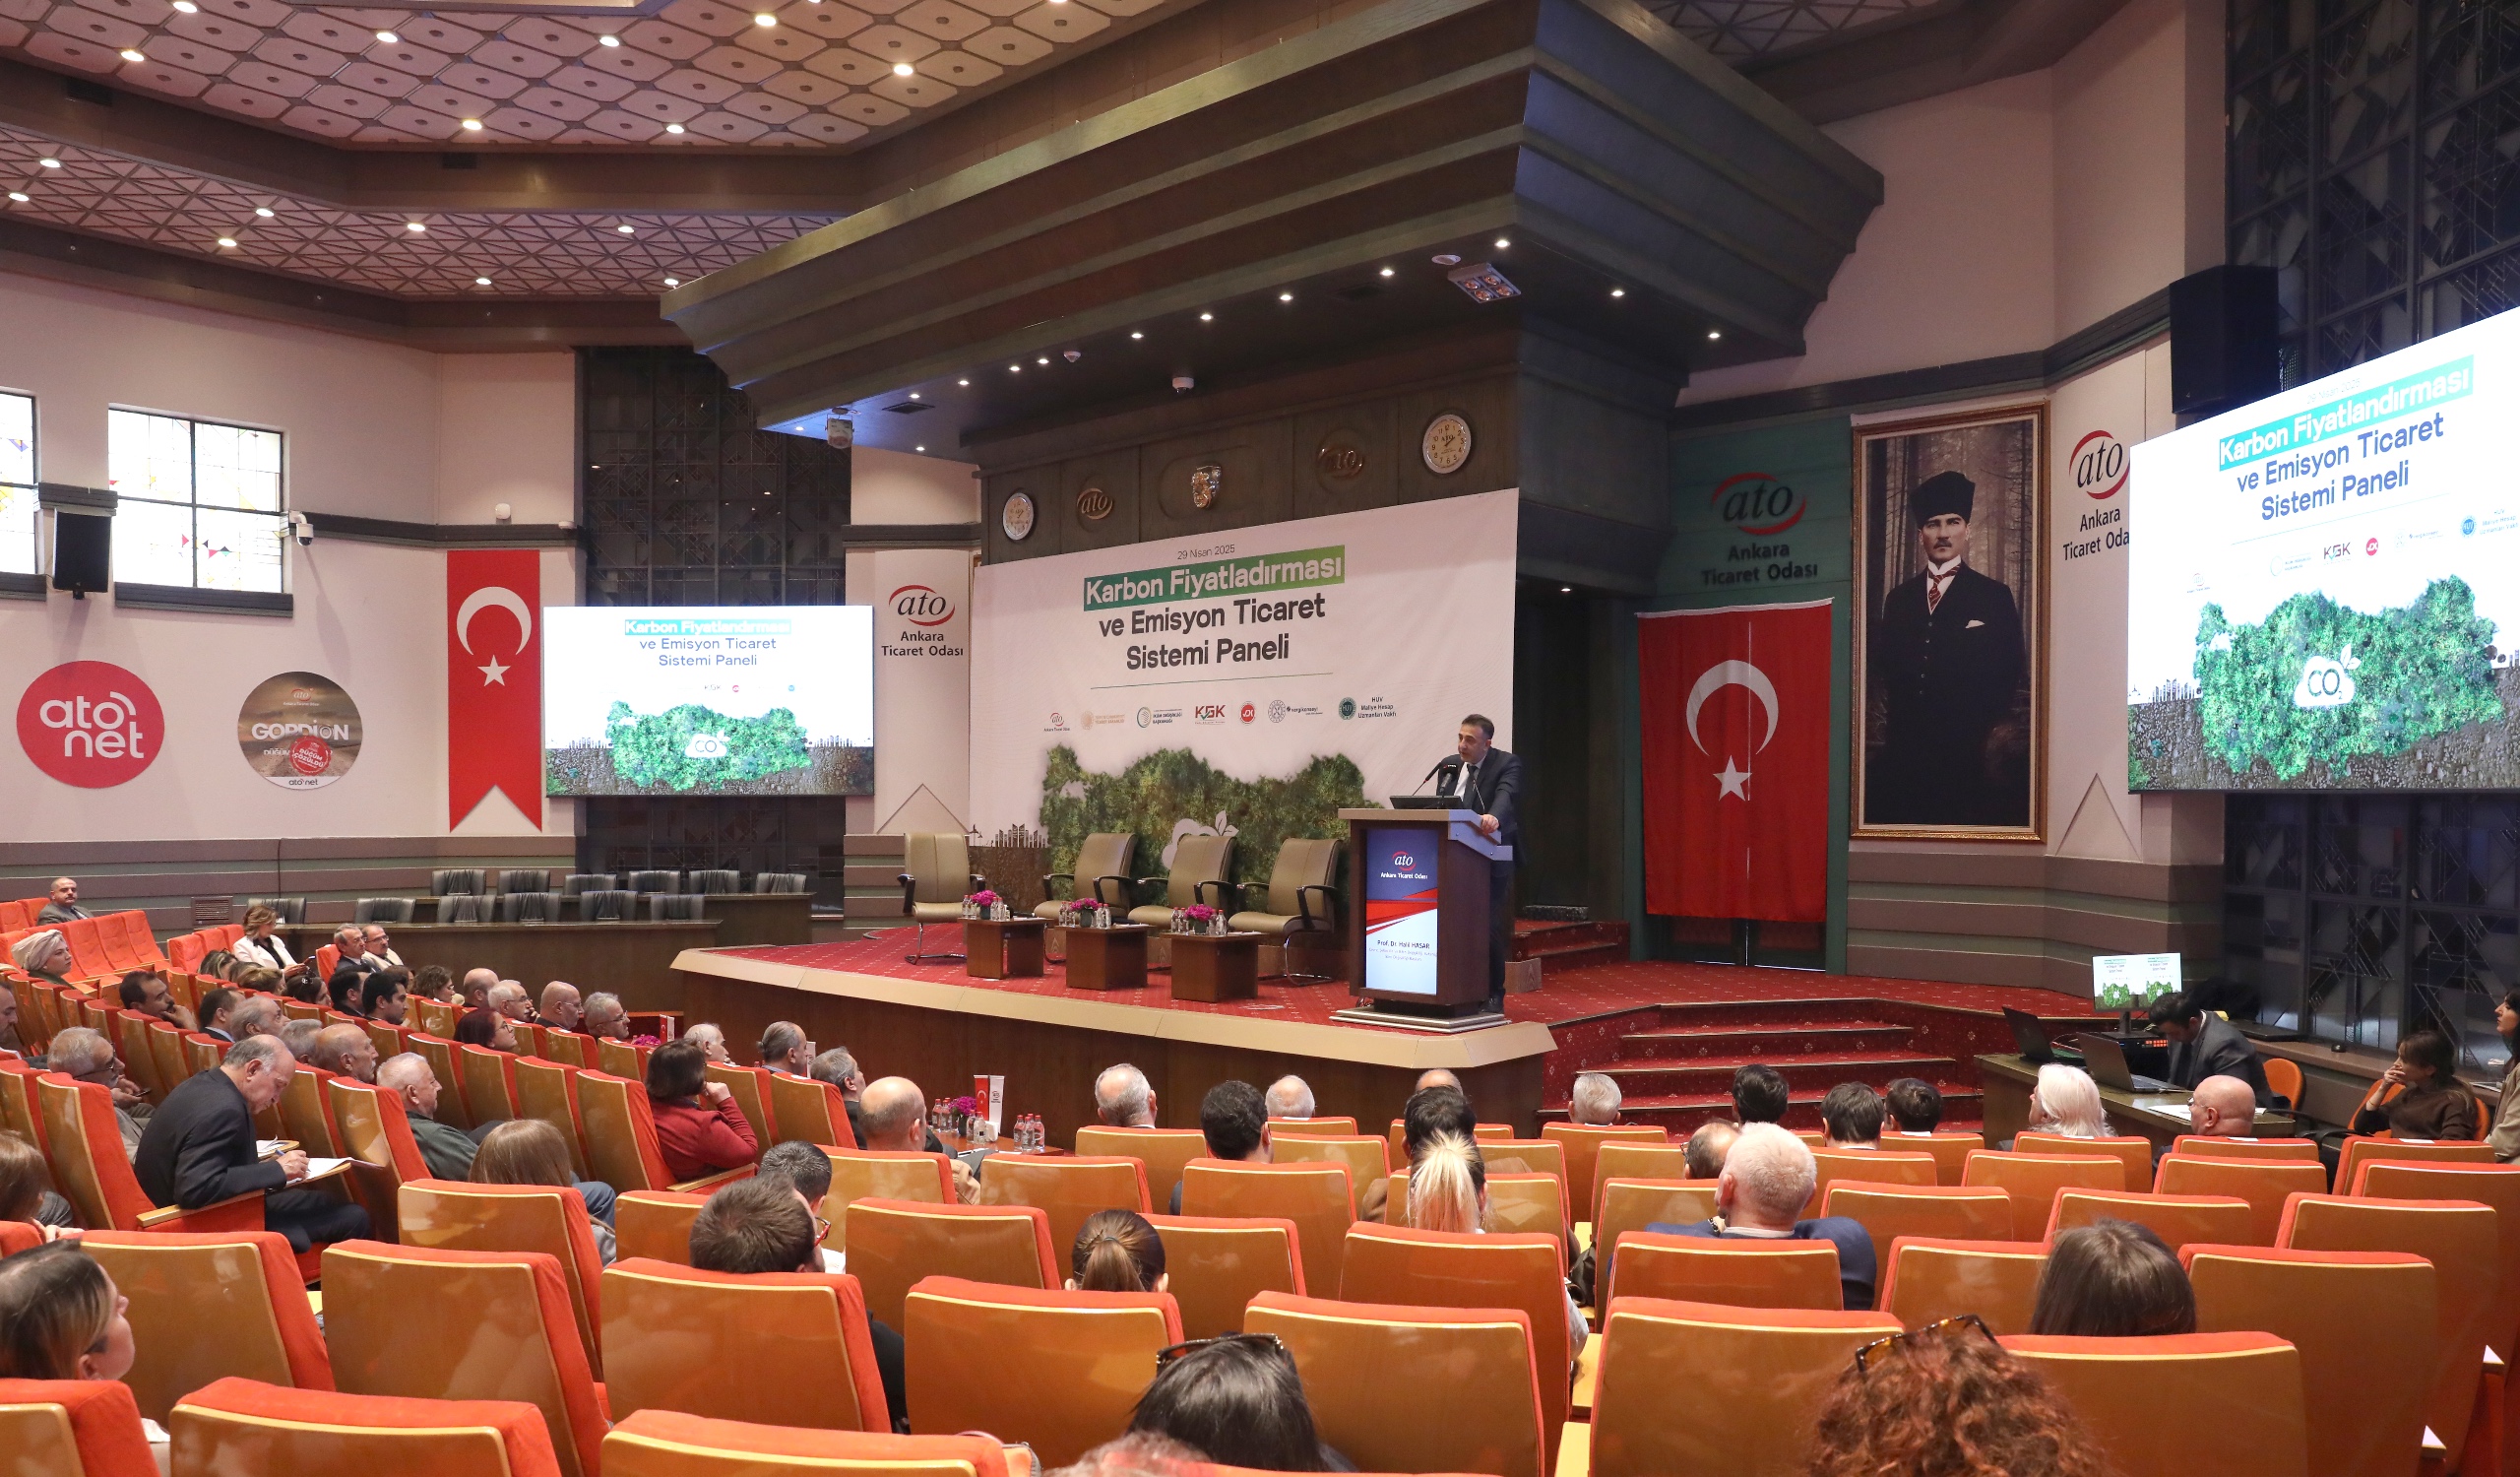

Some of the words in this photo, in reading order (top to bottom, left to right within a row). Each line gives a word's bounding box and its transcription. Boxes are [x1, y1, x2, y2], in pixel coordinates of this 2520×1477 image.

[2220, 427, 2288, 465] Karbon
[2294, 368, 2470, 442] Fiyatlandırması
[2237, 472, 2258, 492] ve
[2266, 445, 2349, 485] Emisyon
[2358, 412, 2444, 459] Ticaret
[2261, 480, 2335, 521] Sistemi
[2343, 460, 2409, 500] Paneli
[2080, 508, 2120, 532] Ankara
[1177, 550, 1188, 560] 29
[1190, 548, 1212, 558] Nisan
[1215, 545, 1235, 554] 2025
[1728, 543, 1790, 561] Ankara
[2063, 537, 2101, 560] Ticaret
[2107, 528, 2129, 548] Oda
[1086, 577, 1164, 605] Karbon
[1170, 557, 1342, 598] Fiyatladırması
[1702, 567, 1759, 585] Ticaret
[1768, 561, 1817, 580] Odası
[625, 620, 678, 633] Karbon
[1100, 618, 1124, 637] ve
[1132, 607, 1225, 634] Emisyon
[1233, 593, 1325, 624] Ticaret
[662, 638, 720, 651] Emisyon
[725, 638, 777, 649] Ticaret
[901, 630, 944, 641] Ankara
[659, 655, 711, 666] Sistemi
[716, 655, 757, 666] Paneli
[881, 645, 923, 656] Ticaret
[929, 645, 964, 656] Odası
[1126, 640, 1209, 671] Sistemi
[1217, 633, 1289, 663] Paneli
[39, 696, 124, 730] ato
[1195, 705, 1226, 719] KGK
[65, 722, 144, 758] net
